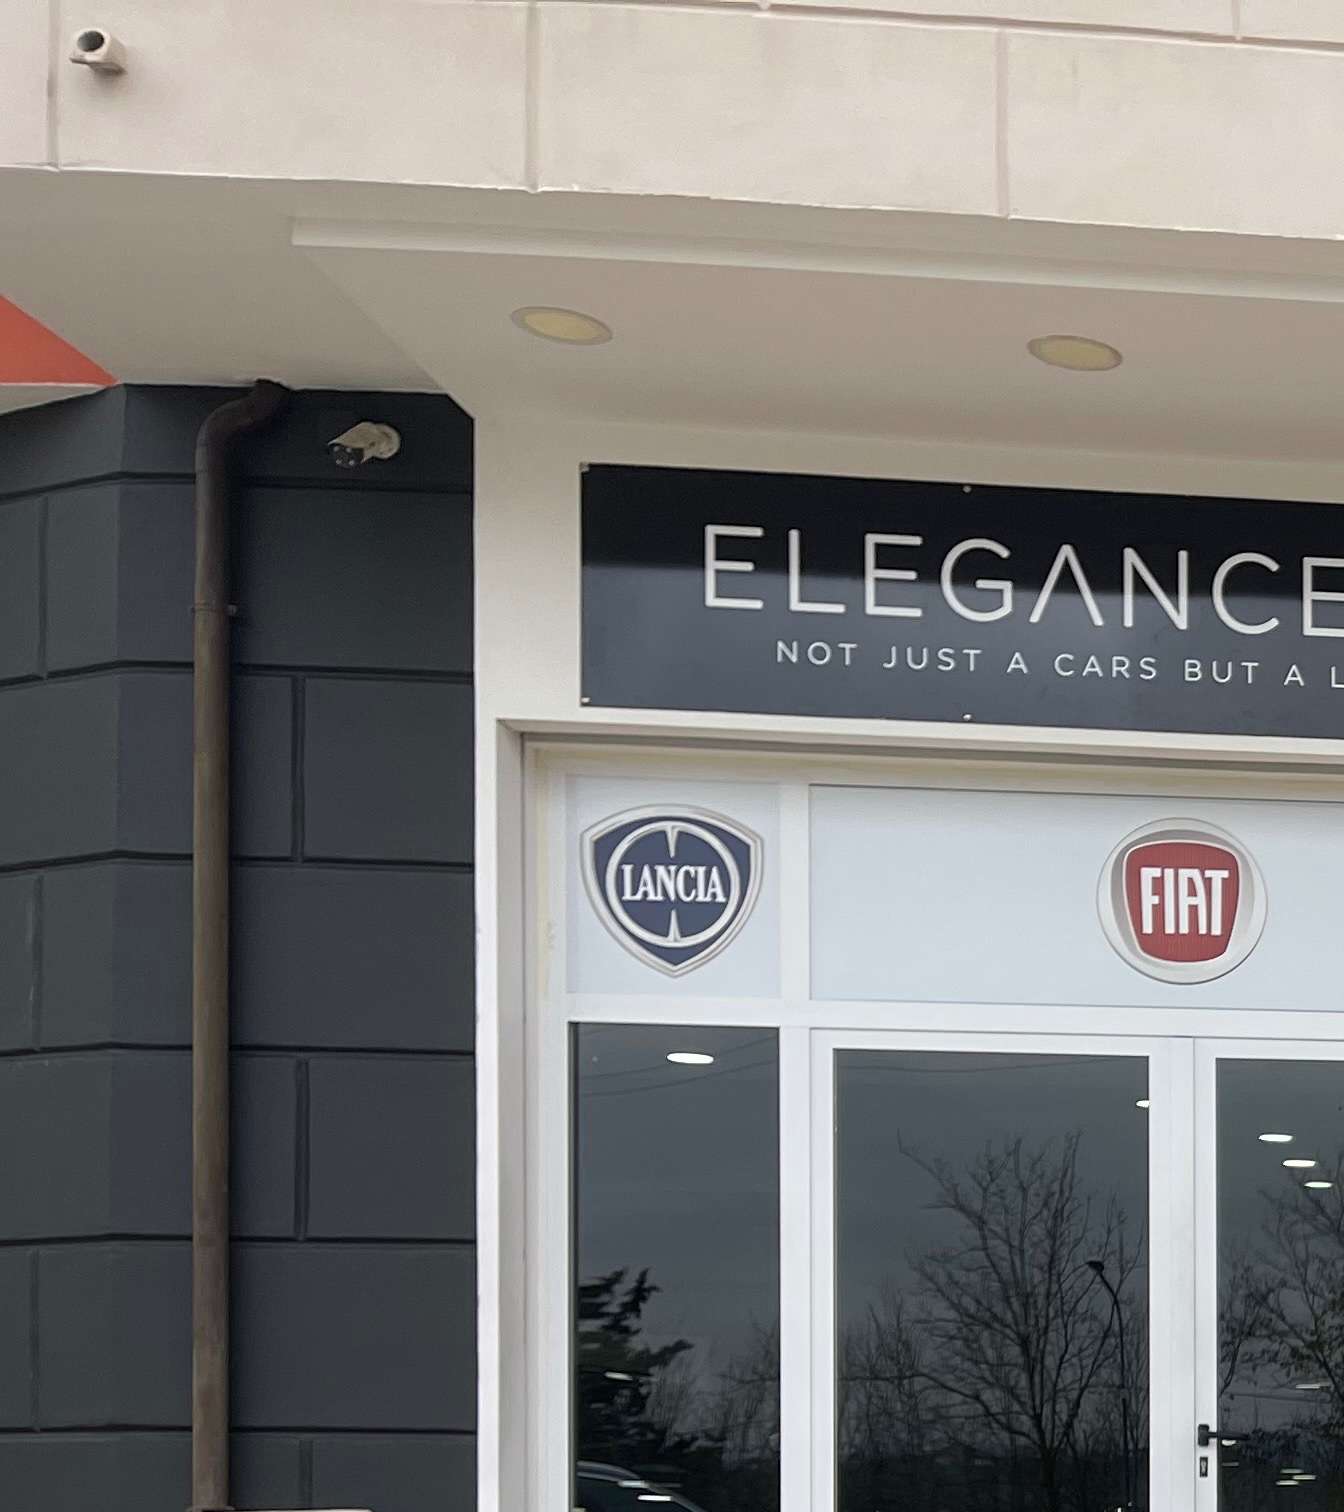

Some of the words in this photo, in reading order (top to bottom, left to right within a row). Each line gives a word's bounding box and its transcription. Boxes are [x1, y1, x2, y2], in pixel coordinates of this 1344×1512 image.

[776, 640, 858, 666] NOT
[882, 645, 983, 672] JUST
[1006, 651, 1029, 674] A
[1054, 653, 1157, 680] CARS
[1184, 659, 1260, 684] BUT
[1283, 664, 1305, 687] A
[620, 863, 726, 903] LANCIA
[1139, 866, 1230, 936] FIAT
